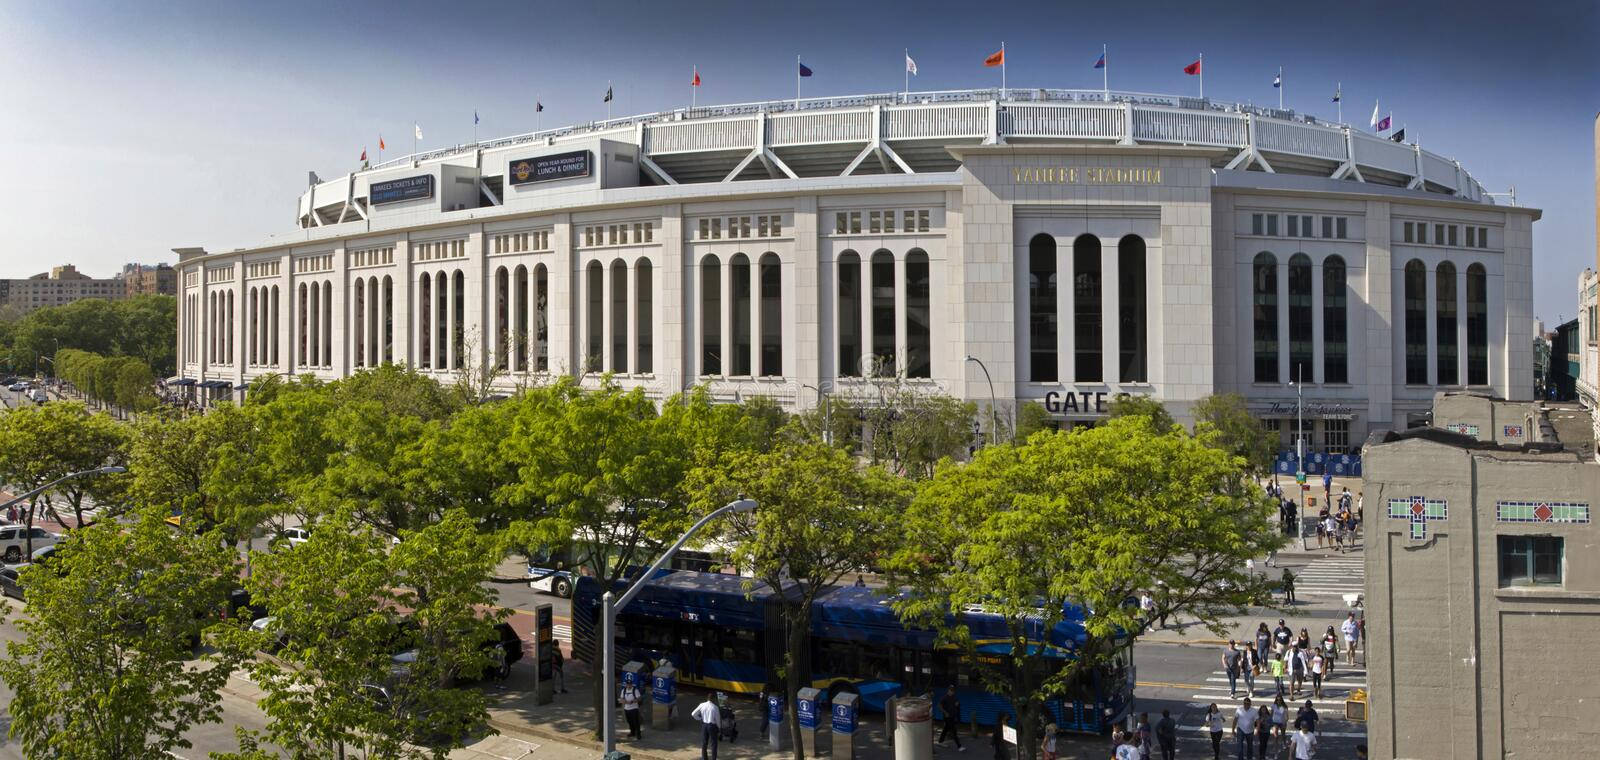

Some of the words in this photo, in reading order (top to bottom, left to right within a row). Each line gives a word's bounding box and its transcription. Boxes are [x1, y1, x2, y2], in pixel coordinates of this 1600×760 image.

[538, 166, 557, 175] LUNCH
[563, 162, 585, 172] DINNER
[1012, 167, 1080, 184] YANKEE
[1087, 167, 1161, 184] STADIUM
[1045, 391, 1108, 413] GATE
[1268, 402, 1291, 414] New
